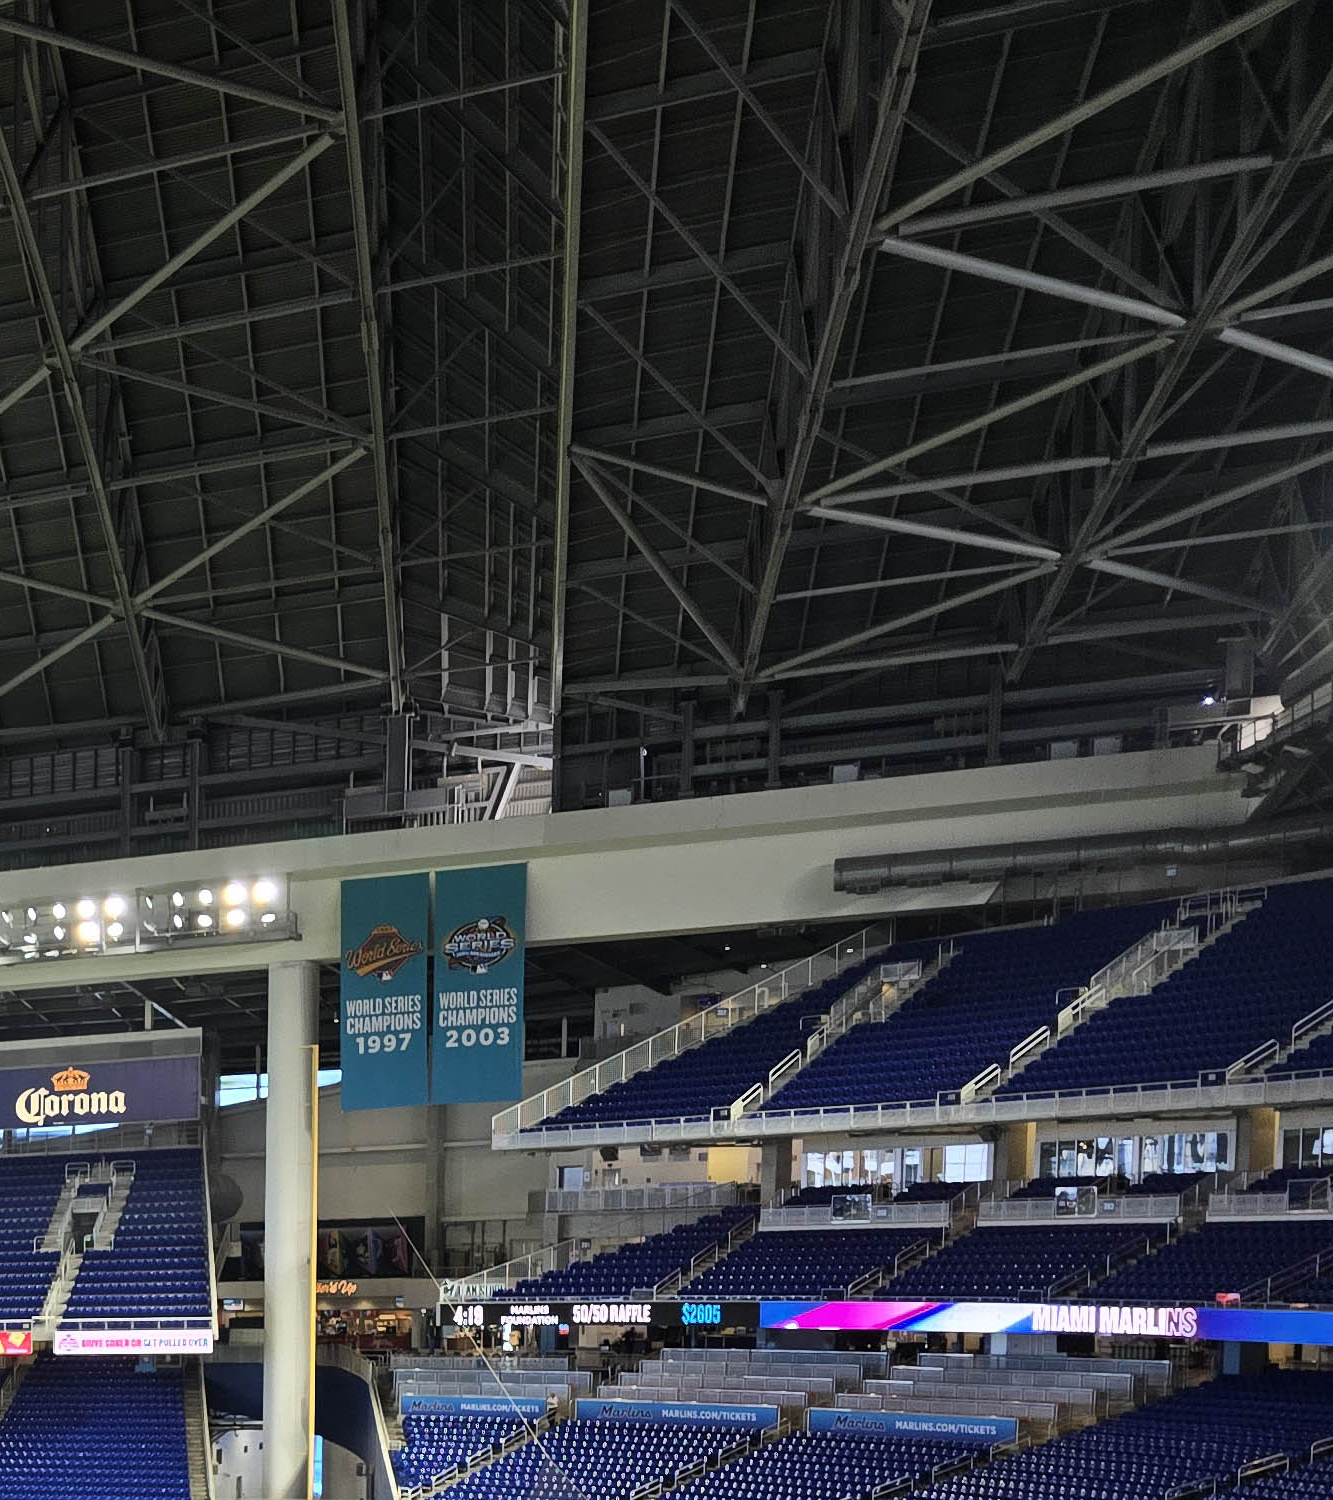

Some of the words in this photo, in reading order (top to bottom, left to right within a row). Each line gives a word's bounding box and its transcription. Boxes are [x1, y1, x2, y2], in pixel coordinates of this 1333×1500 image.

[444, 938, 516, 954] SERIES
[454, 931, 506, 942] WORLD
[346, 998, 382, 1016] WORLD
[384, 994, 422, 1014] SERIES
[439, 990, 477, 1009] WORLD
[479, 987, 517, 1006] SERIES
[346, 1012, 422, 1035] CHAMPIONS
[439, 1005, 517, 1027] CHAMPIONS
[356, 1032, 412, 1055] 1997
[445, 1027, 510, 1048] 2003
[15, 1086, 126, 1126] Corona
[500, 1314, 559, 1326] FOUNDATION
[510, 1304, 549, 1315] MARLINS
[572, 1304, 608, 1324] 50/50
[609, 1304, 651, 1323] RAFFLE
[1033, 1304, 1096, 1333] MIAMI
[1099, 1306, 1198, 1338] MARLINS
[410, 1398, 455, 1415] Marlins
[460, 1401, 542, 1413] MARLINS.COM/TICKETS
[599, 1403, 654, 1420] Marlins
[661, 1407, 757, 1424] MARLINS.COM/TICKETS
[834, 1413, 887, 1432] Marlins
[895, 1420, 997, 1436] MARLINS.COM/TICKETS
